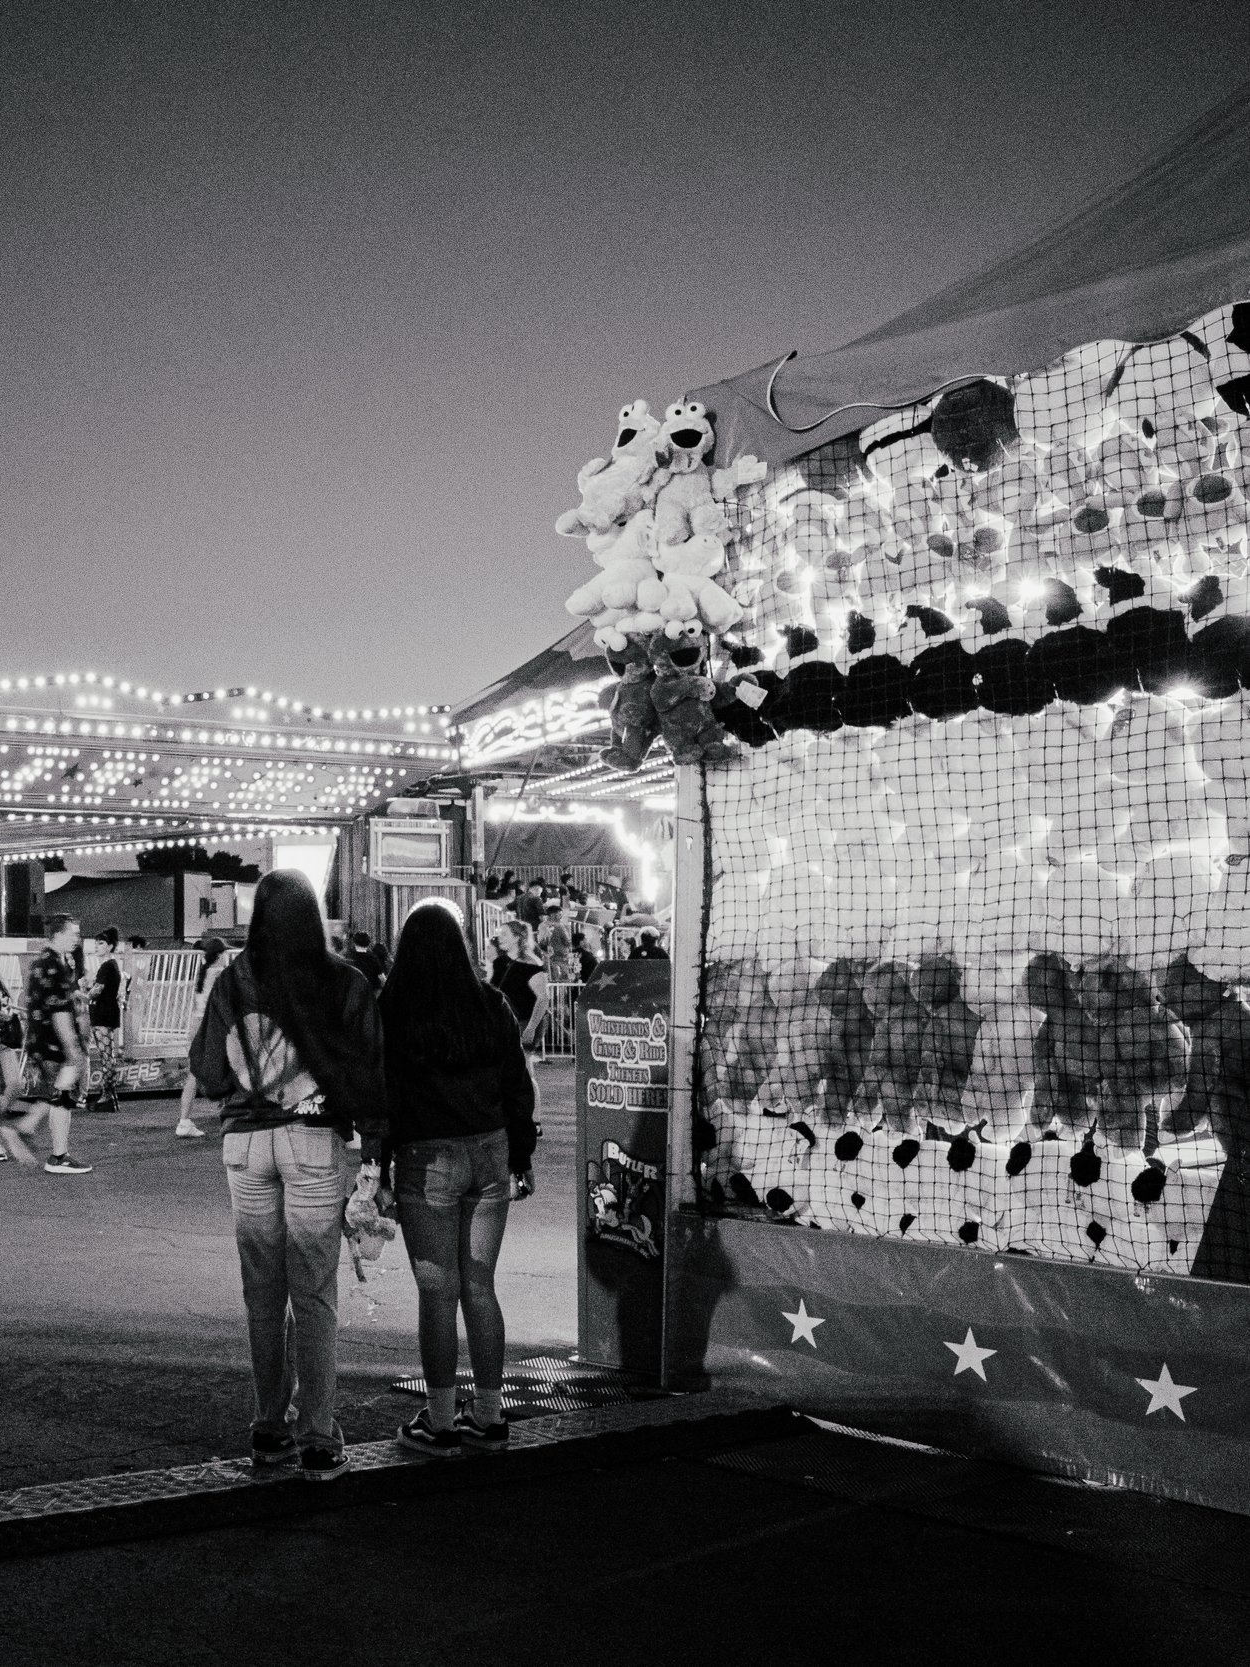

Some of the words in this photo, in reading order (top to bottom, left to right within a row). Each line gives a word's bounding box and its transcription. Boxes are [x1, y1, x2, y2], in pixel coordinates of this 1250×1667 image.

[652, 1016, 666, 1039] &
[592, 1036, 622, 1058] GAME
[623, 1039, 637, 1060] &
[638, 1040, 666, 1061] RIDE
[608, 1061, 650, 1084] TICKETS
[589, 1081, 624, 1105] SOLD
[606, 1141, 658, 1180] BUTLER
